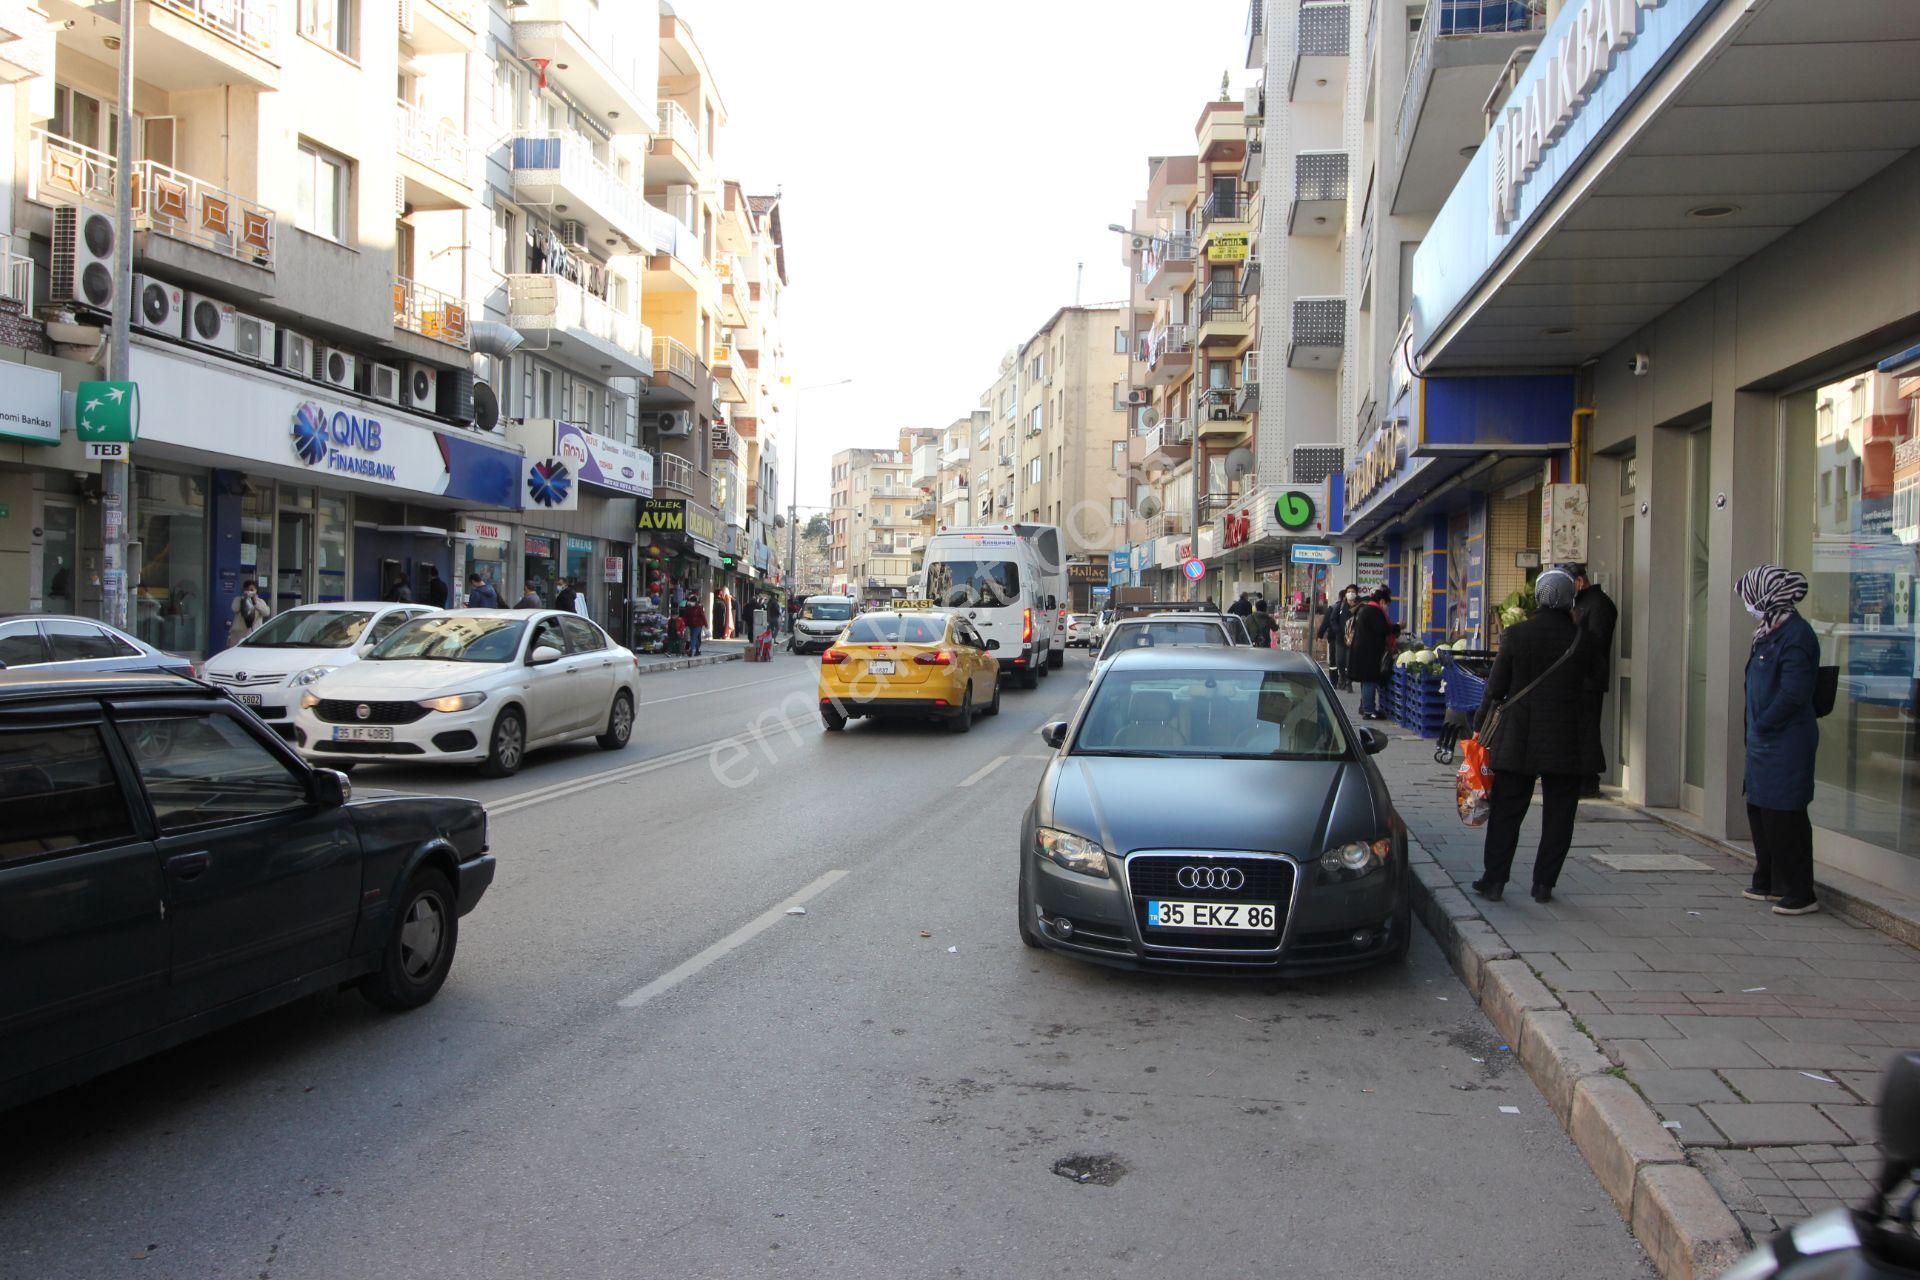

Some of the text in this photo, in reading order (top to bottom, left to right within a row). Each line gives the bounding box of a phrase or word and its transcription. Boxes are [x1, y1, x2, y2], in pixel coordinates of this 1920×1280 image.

[21, 414, 52, 428] Bankası
[332, 410, 381, 451] QNB
[91, 444, 122, 456] TEB
[638, 511, 683, 530] AVM
[242, 695, 260, 705] 5802
[1159, 903, 1185, 925] 35
[1193, 904, 1239, 927] EKZ
[1247, 906, 1274, 928] 86
